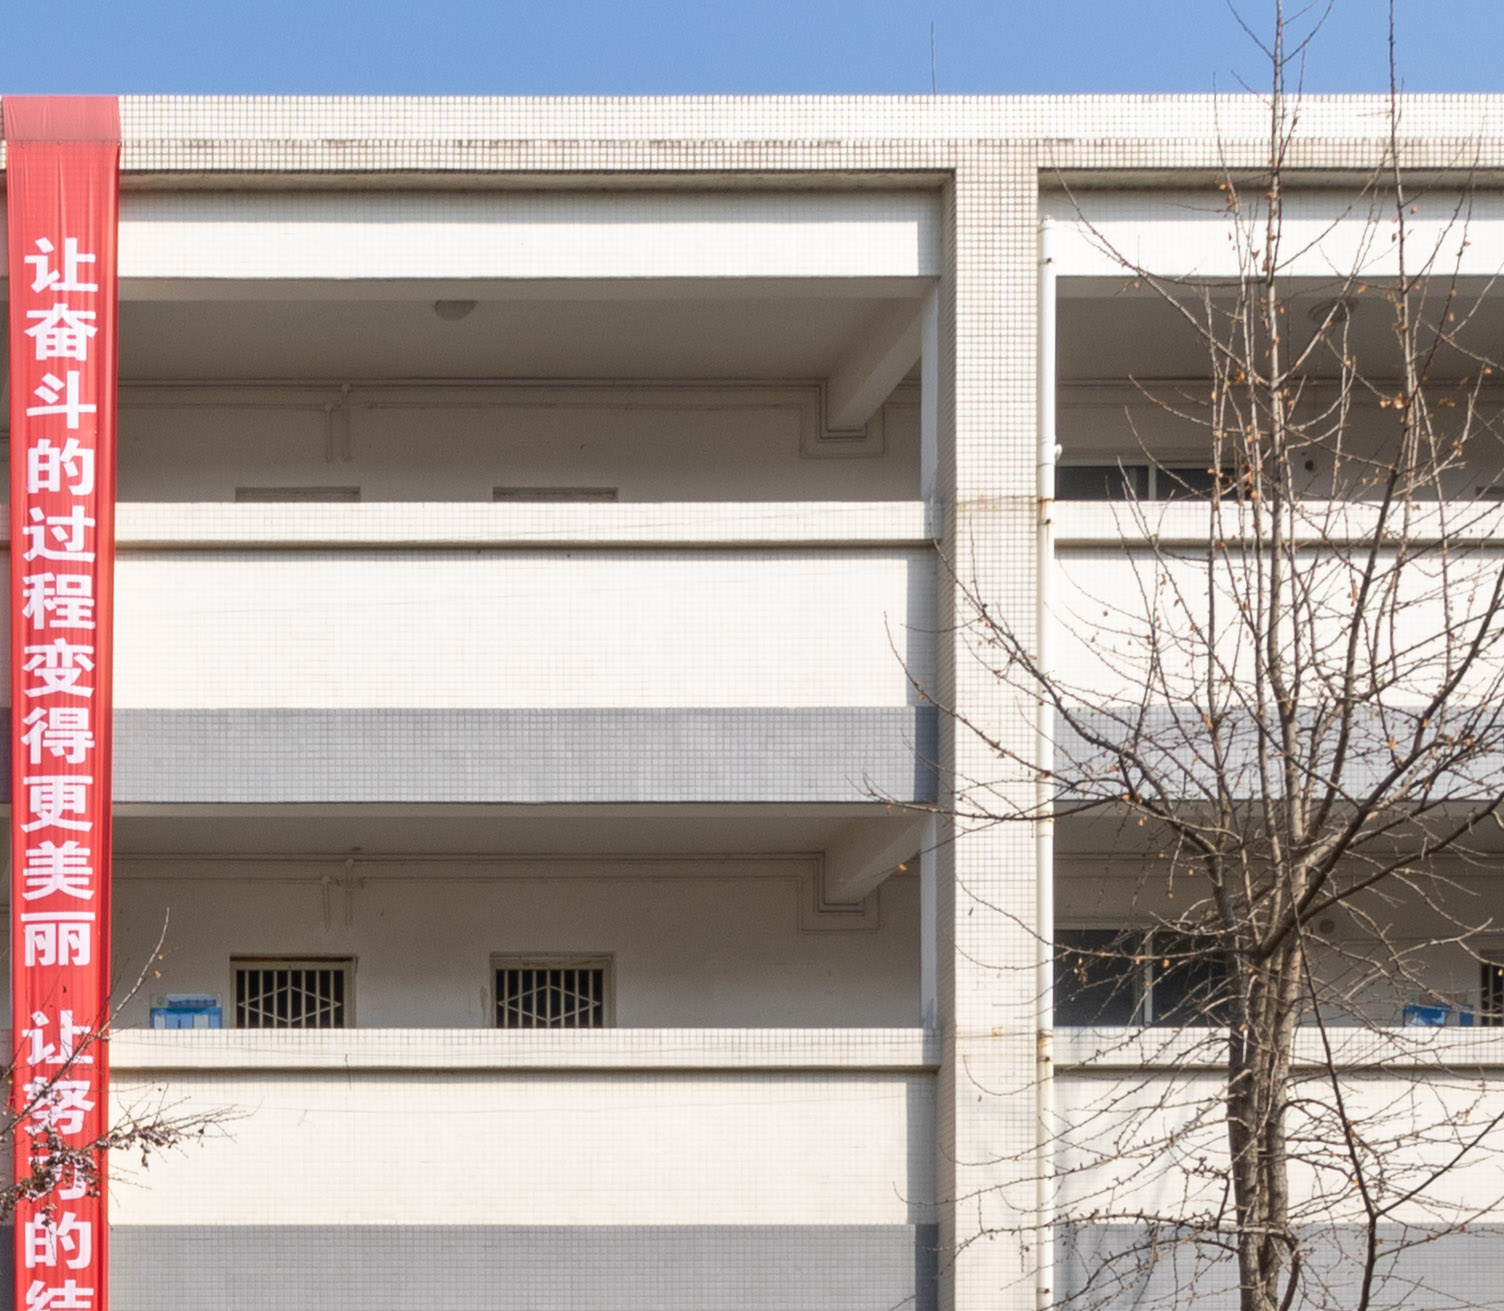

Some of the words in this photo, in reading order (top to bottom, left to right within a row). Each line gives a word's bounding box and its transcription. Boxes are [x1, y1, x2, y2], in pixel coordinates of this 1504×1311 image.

[21, 237, 98, 967] 让奋斗的过程变得更美丽
